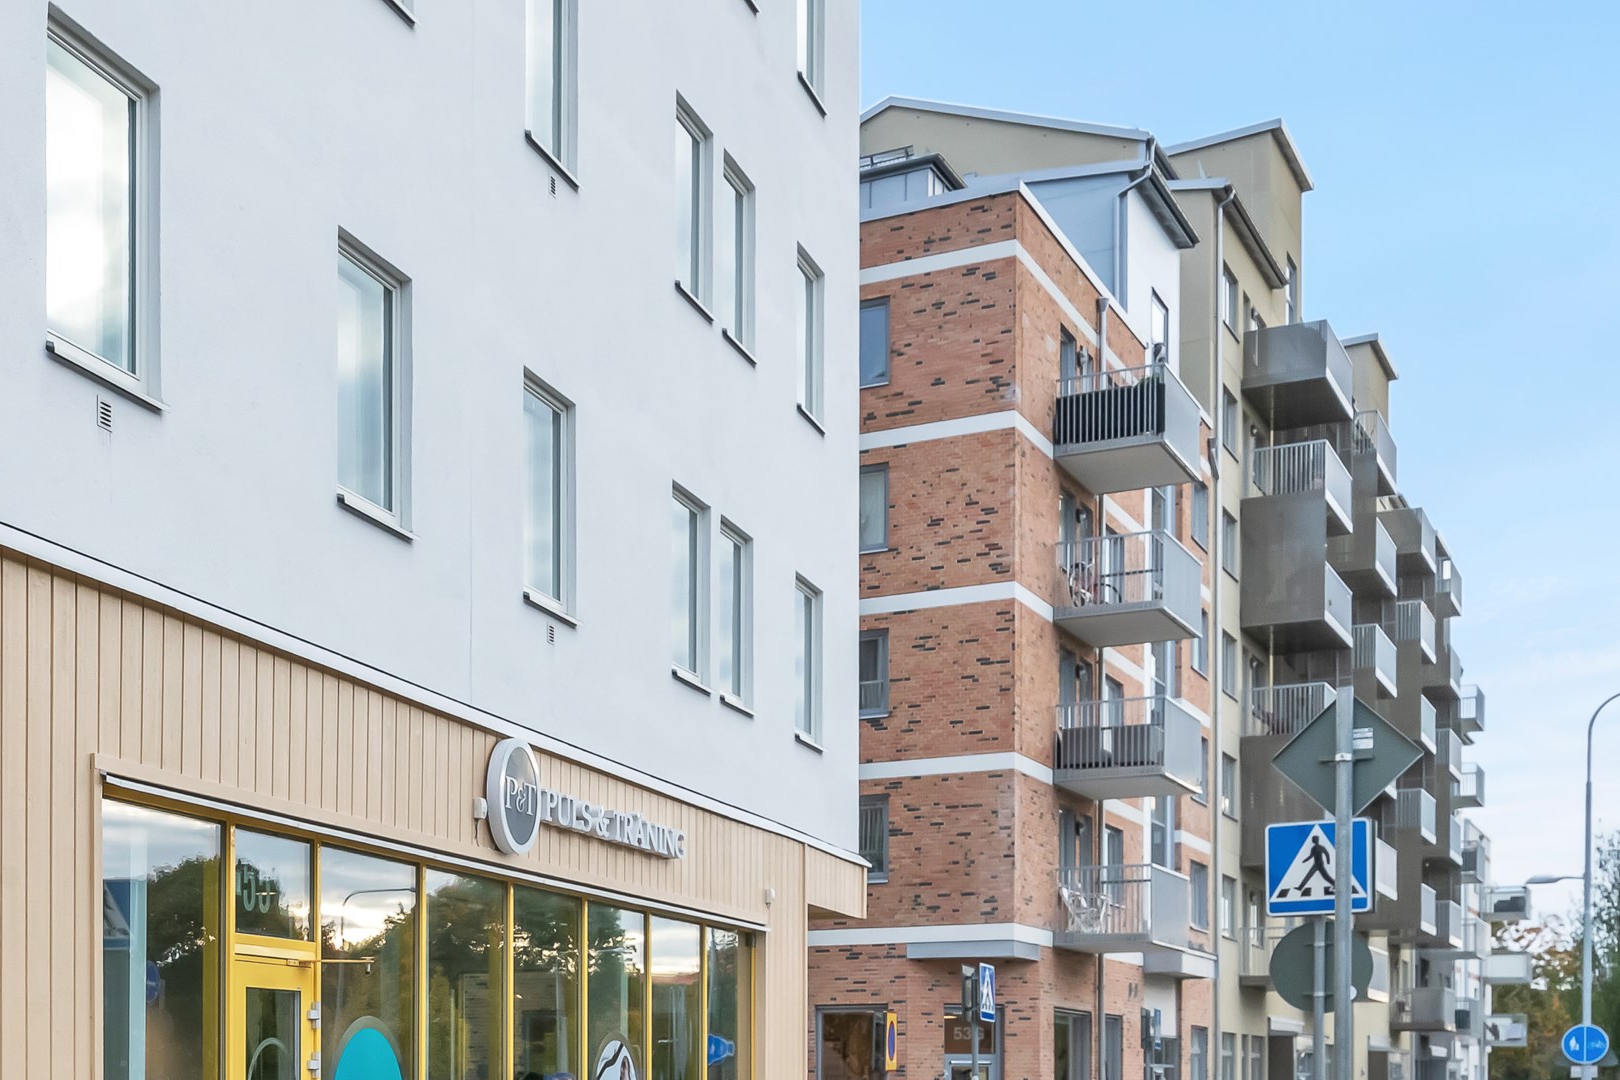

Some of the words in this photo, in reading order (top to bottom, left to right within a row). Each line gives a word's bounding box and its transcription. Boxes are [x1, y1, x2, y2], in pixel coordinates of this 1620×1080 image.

[505, 775, 537, 816] P&T
[545, 788, 592, 832] PULS
[595, 805, 610, 838] &
[954, 1026, 972, 1040] 53
